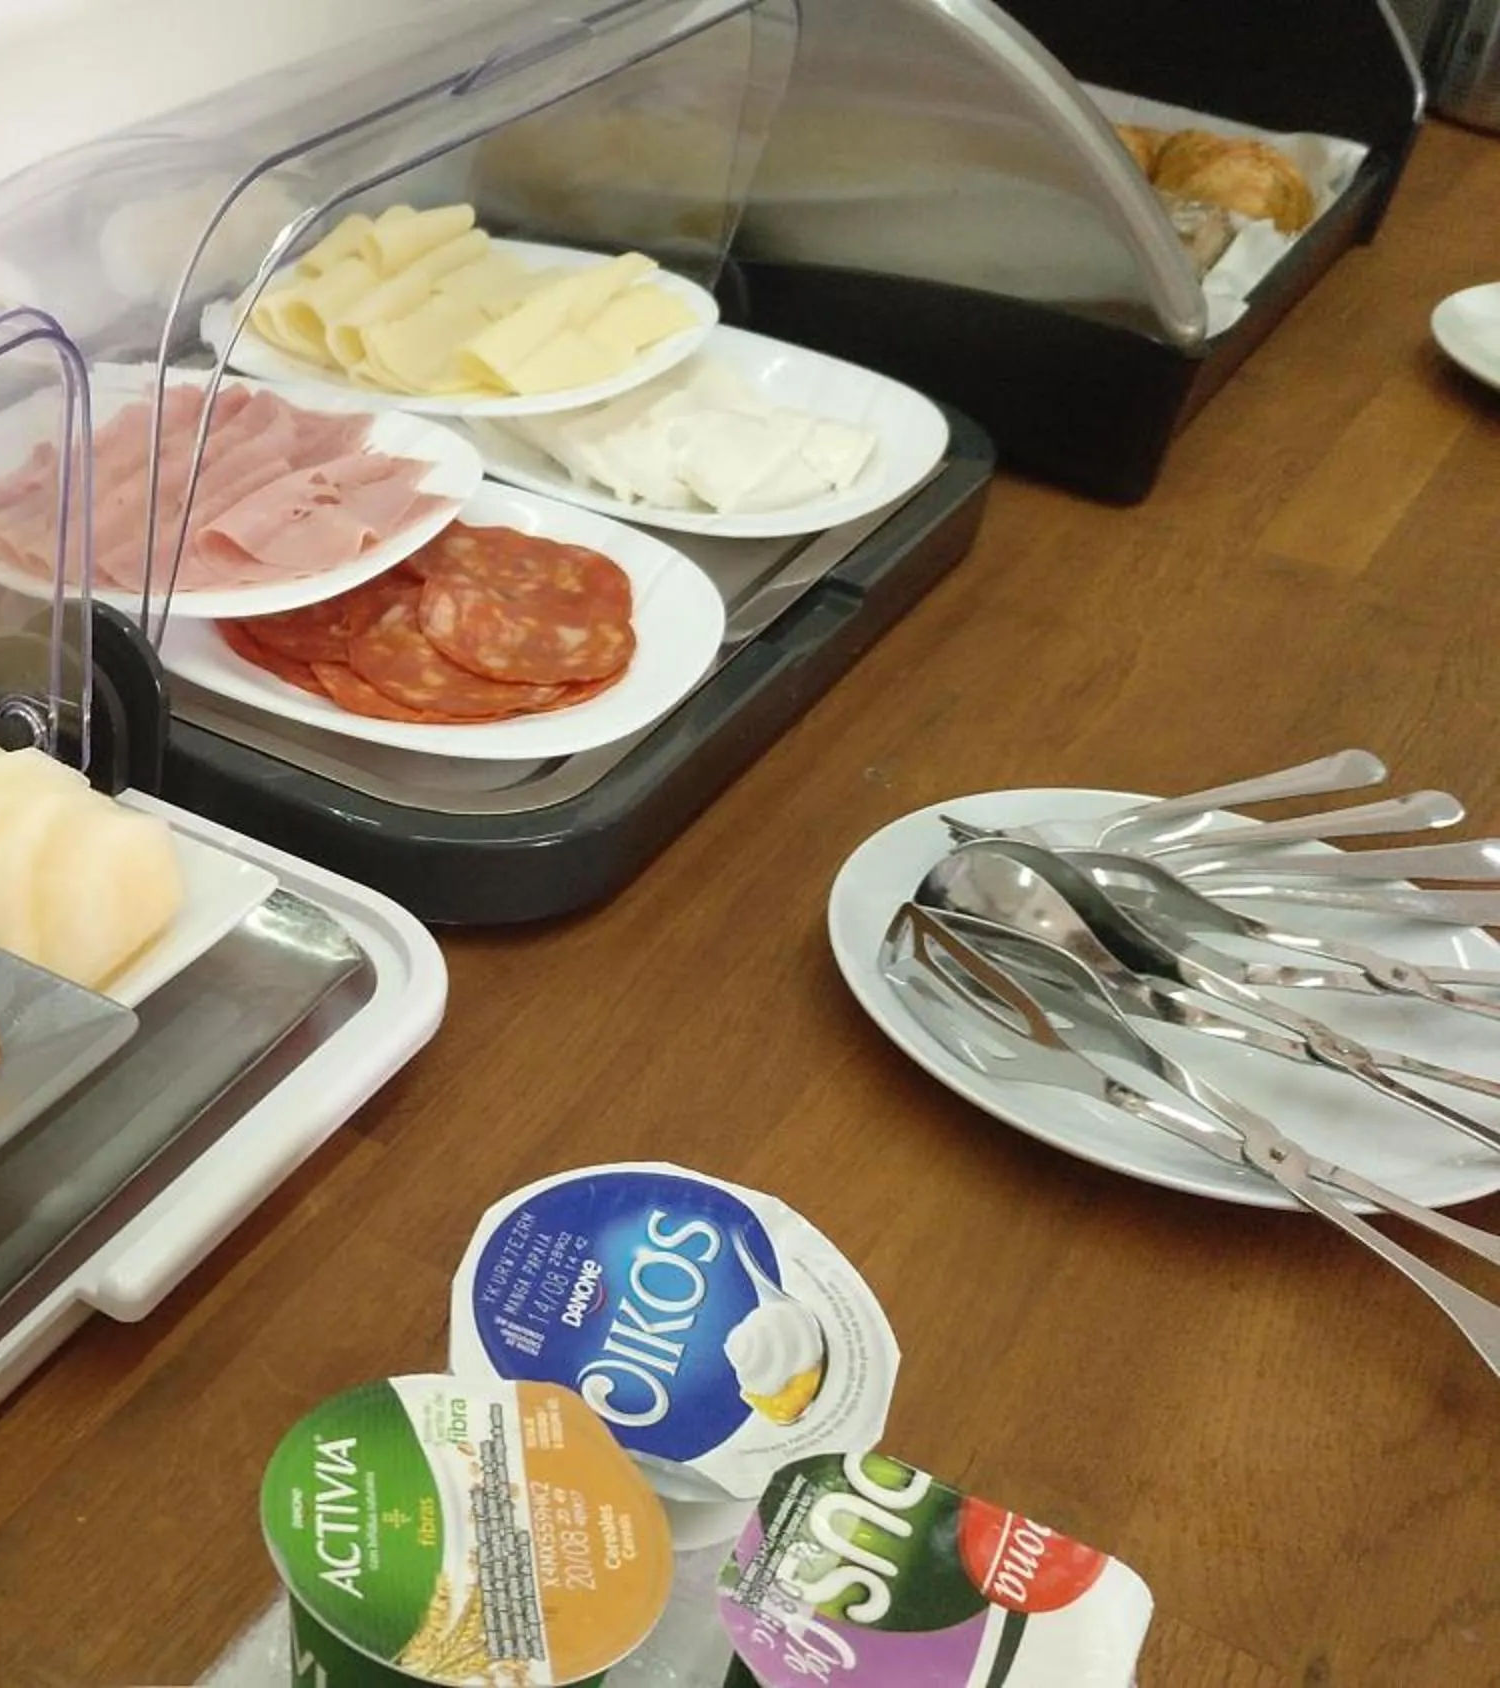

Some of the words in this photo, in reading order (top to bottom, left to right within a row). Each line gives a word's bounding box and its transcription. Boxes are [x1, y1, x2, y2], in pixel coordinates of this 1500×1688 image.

[528, 1271, 569, 1324] 14/08
[579, 1211, 722, 1427] OIKOS
[315, 1437, 363, 1599] ACTIVIA
[418, 1497, 437, 1546] fibras
[560, 1530, 596, 1591] 20/08
